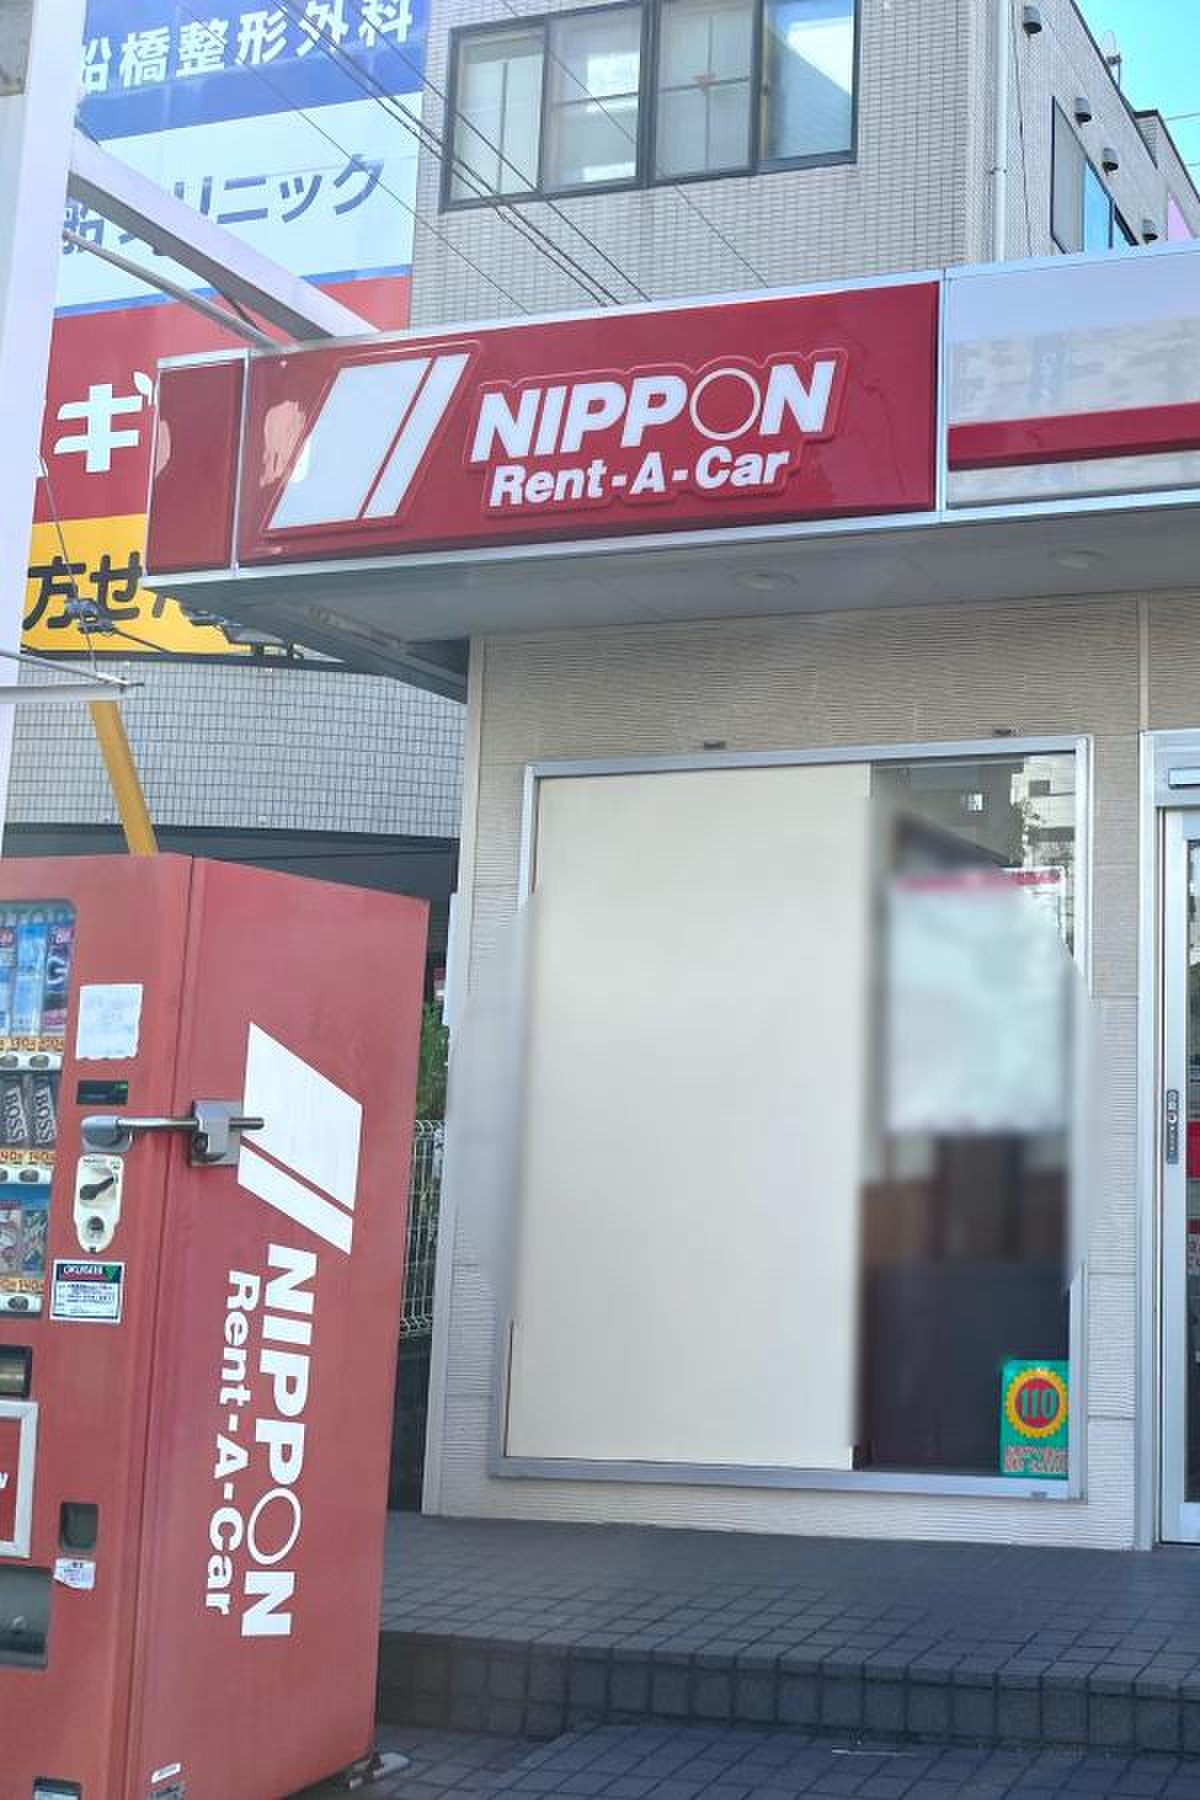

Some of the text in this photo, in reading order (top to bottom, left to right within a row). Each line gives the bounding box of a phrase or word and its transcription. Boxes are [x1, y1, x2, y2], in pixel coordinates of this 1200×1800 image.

[470, 359, 836, 464] NIPPON
[5, 1086, 28, 1143] BOSS
[36, 1086, 57, 1143] BOSS
[205, 1270, 261, 1616] Rent-A-Car
[241, 1243, 318, 1637] NIPPON
[1022, 1387, 1058, 1419] 110
